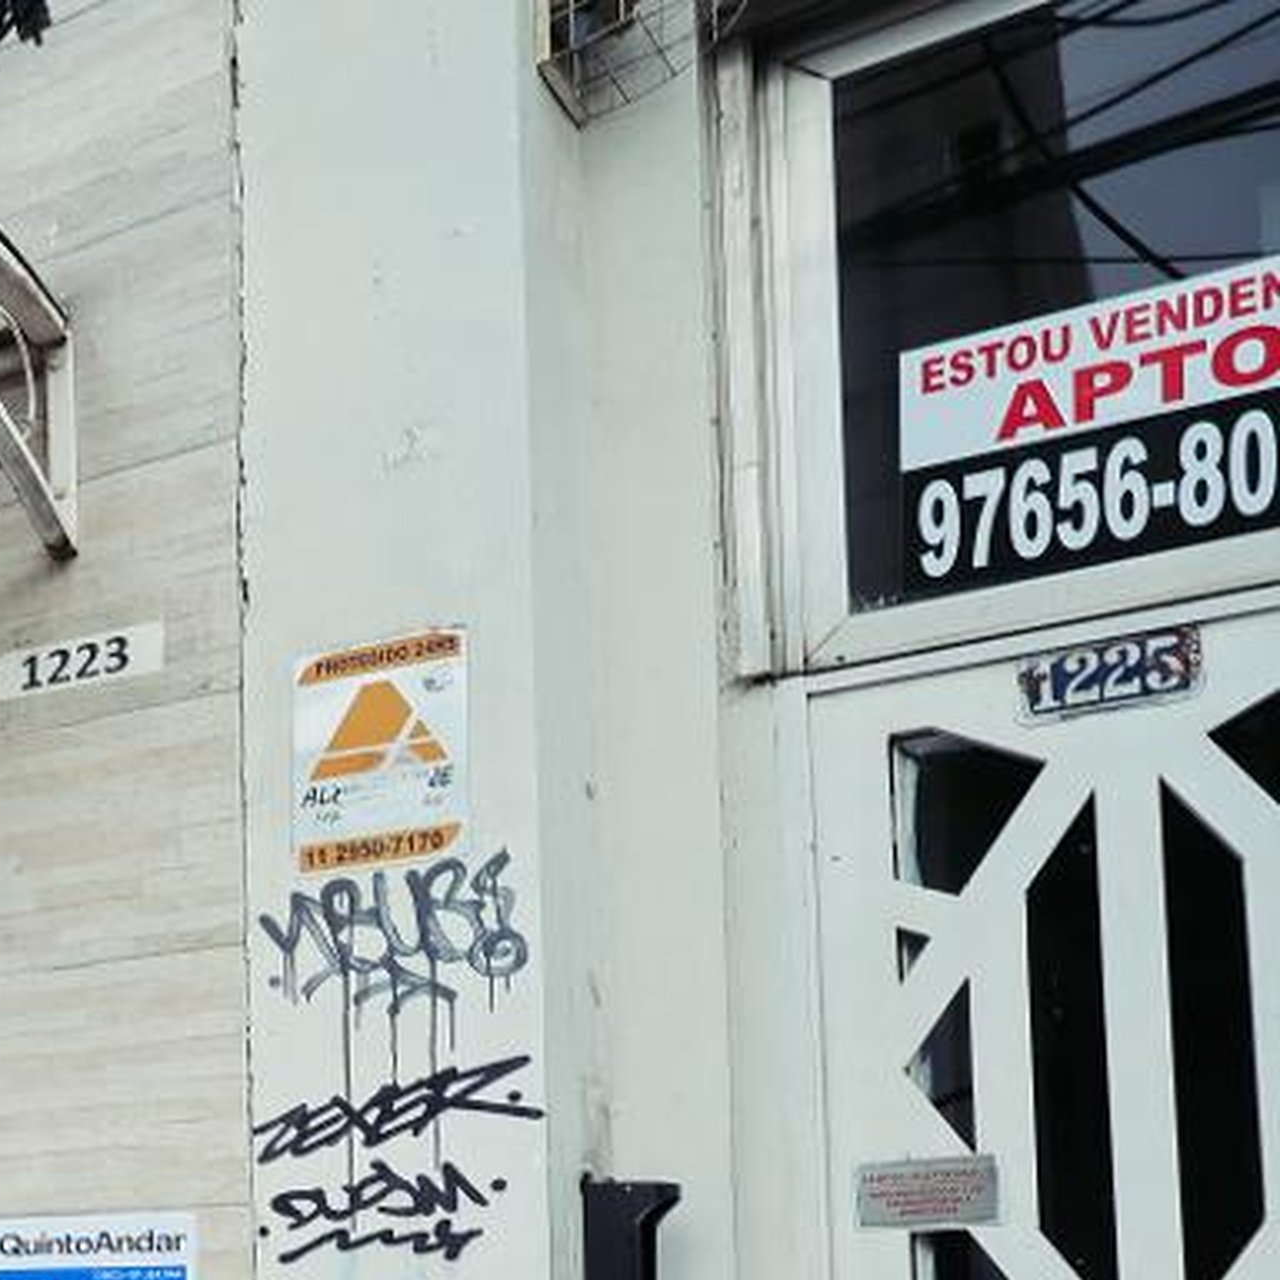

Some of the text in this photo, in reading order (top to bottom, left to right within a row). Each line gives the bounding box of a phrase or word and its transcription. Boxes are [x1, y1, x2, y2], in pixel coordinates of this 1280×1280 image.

[921, 324, 1073, 395] ESTOU
[996, 323, 1280, 442] APTO
[918, 407, 1278, 579] 97656-80
[20, 636, 130, 691] 1223
[1032, 634, 1184, 714] 1225
